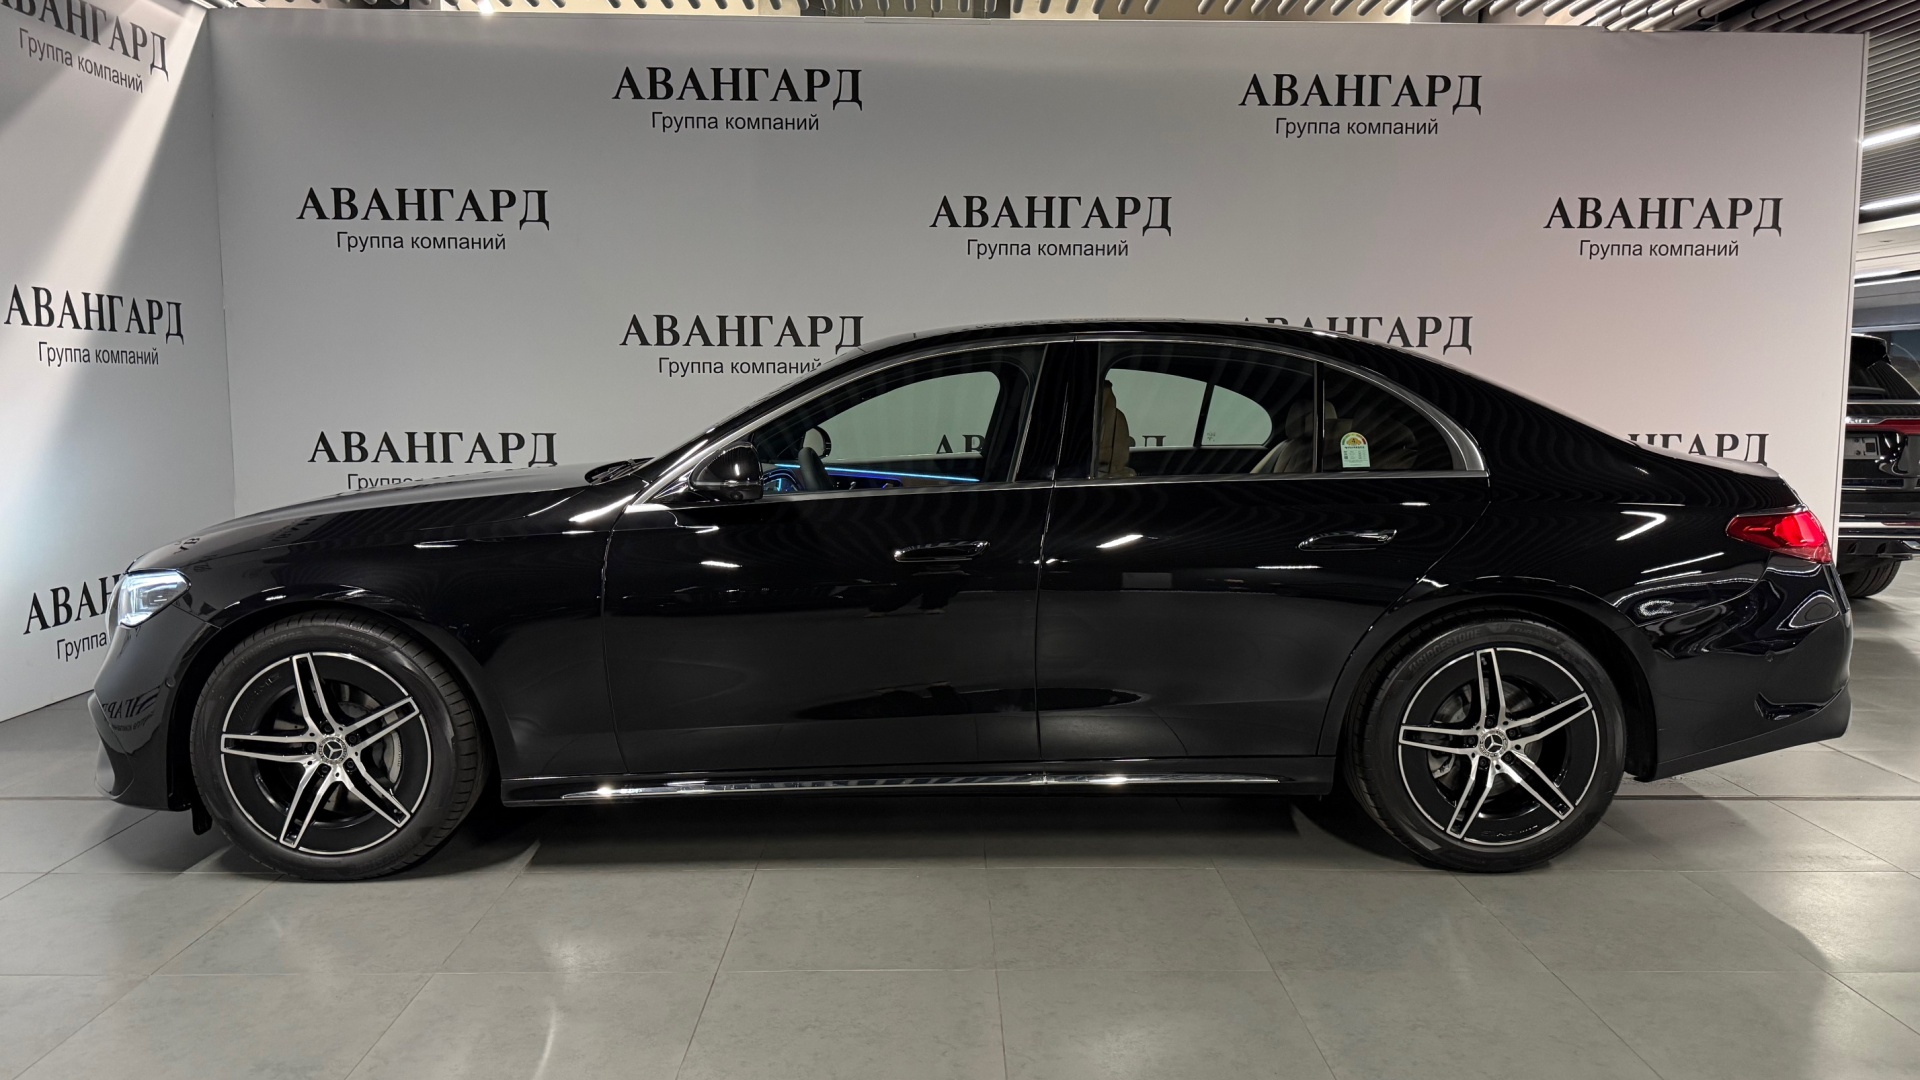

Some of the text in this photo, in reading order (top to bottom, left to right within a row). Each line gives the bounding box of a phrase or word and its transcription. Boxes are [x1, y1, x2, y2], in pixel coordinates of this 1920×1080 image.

[20, 27, 143, 93] Группа компаний
[612, 67, 862, 111] АВАНГАРД
[1238, 74, 1482, 115] АВАНГАРД
[652, 112, 819, 133] Группа компаний
[1276, 118, 1438, 138] Группа компаний
[296, 187, 550, 231] АВАНГАРД
[929, 195, 1172, 236] АВАНГАРД
[1543, 197, 1783, 237] АВАНГАРД
[337, 232, 506, 252] Группа компаний
[967, 239, 1128, 260] Группа компаний
[1579, 240, 1739, 260] Группа компаний
[4, 284, 185, 345] АВАНГАРД
[619, 314, 864, 355] АВАНГАРД
[39, 341, 159, 367] Группа компаний
[659, 357, 724, 378] Группа
[308, 431, 558, 467] АВАНГАРД
[57, 632, 107, 662] Группа
